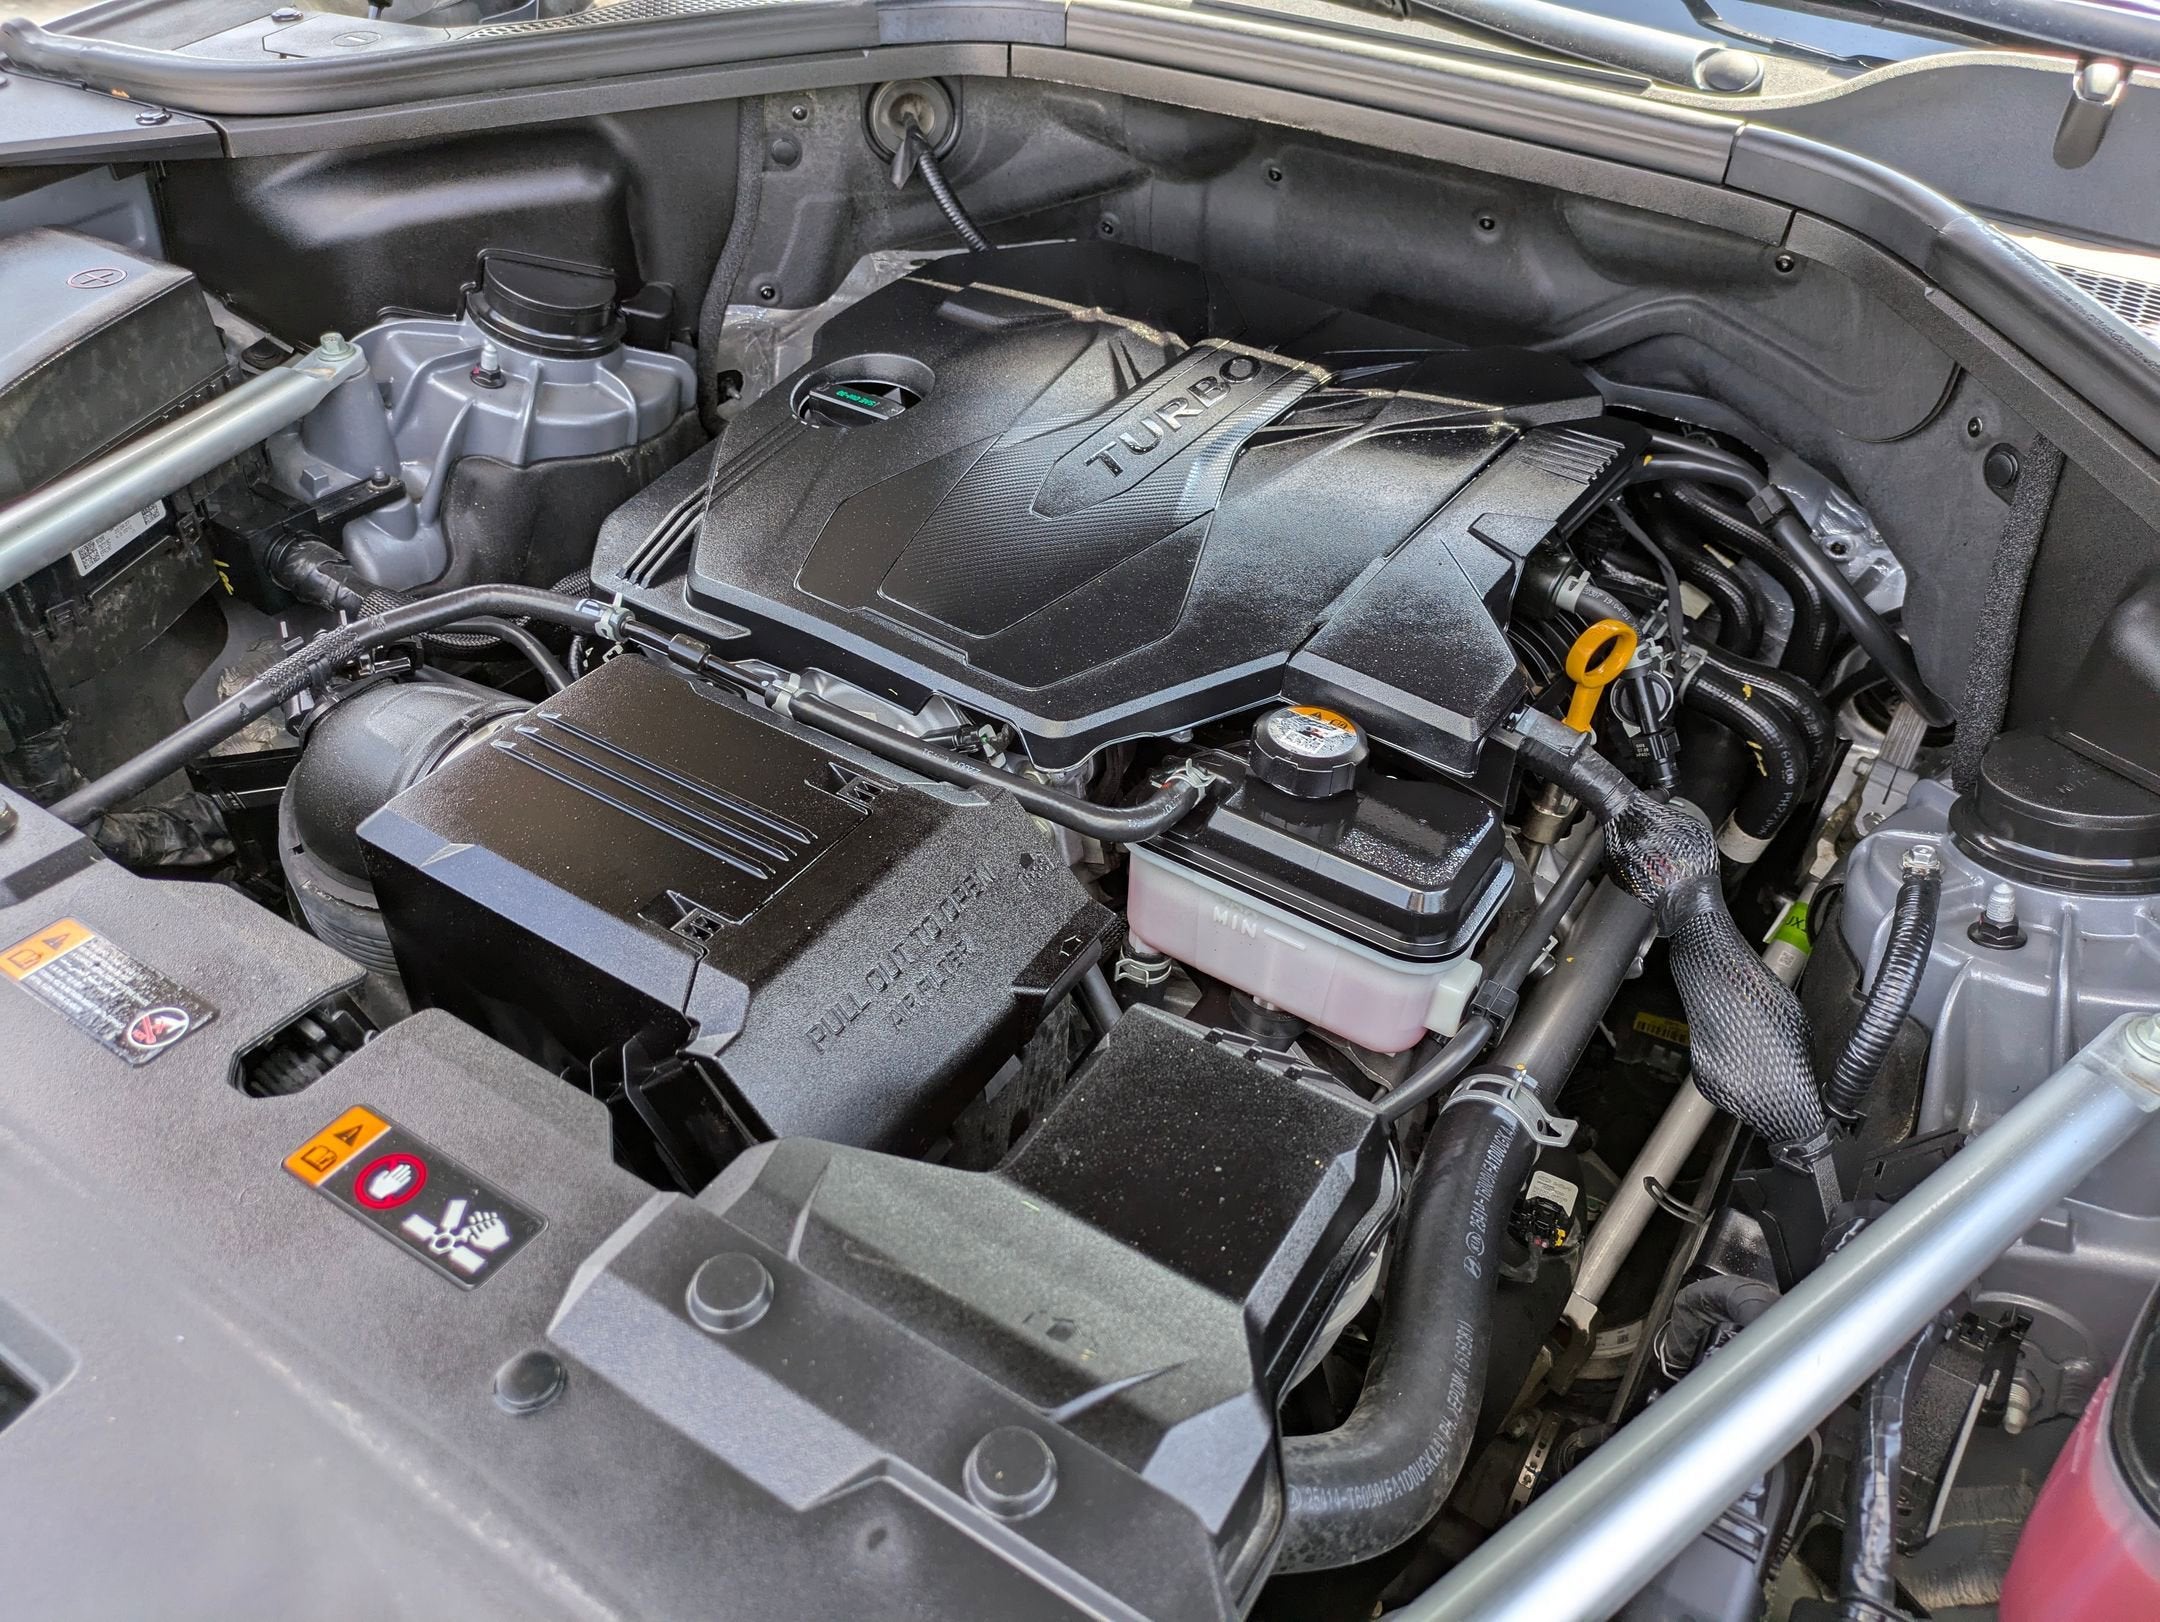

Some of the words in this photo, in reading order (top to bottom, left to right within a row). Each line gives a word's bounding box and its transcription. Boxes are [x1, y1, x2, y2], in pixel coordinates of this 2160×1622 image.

[1084, 354, 1262, 478] TURBO
[804, 990, 872, 1055] PULL
[865, 943, 915, 993] OUT
[908, 914, 943, 946] TO
[938, 863, 996, 923] OPEN
[1212, 905, 1257, 939] MIN
[888, 991, 920, 1029] AIR
[916, 938, 973, 993] FILTER
